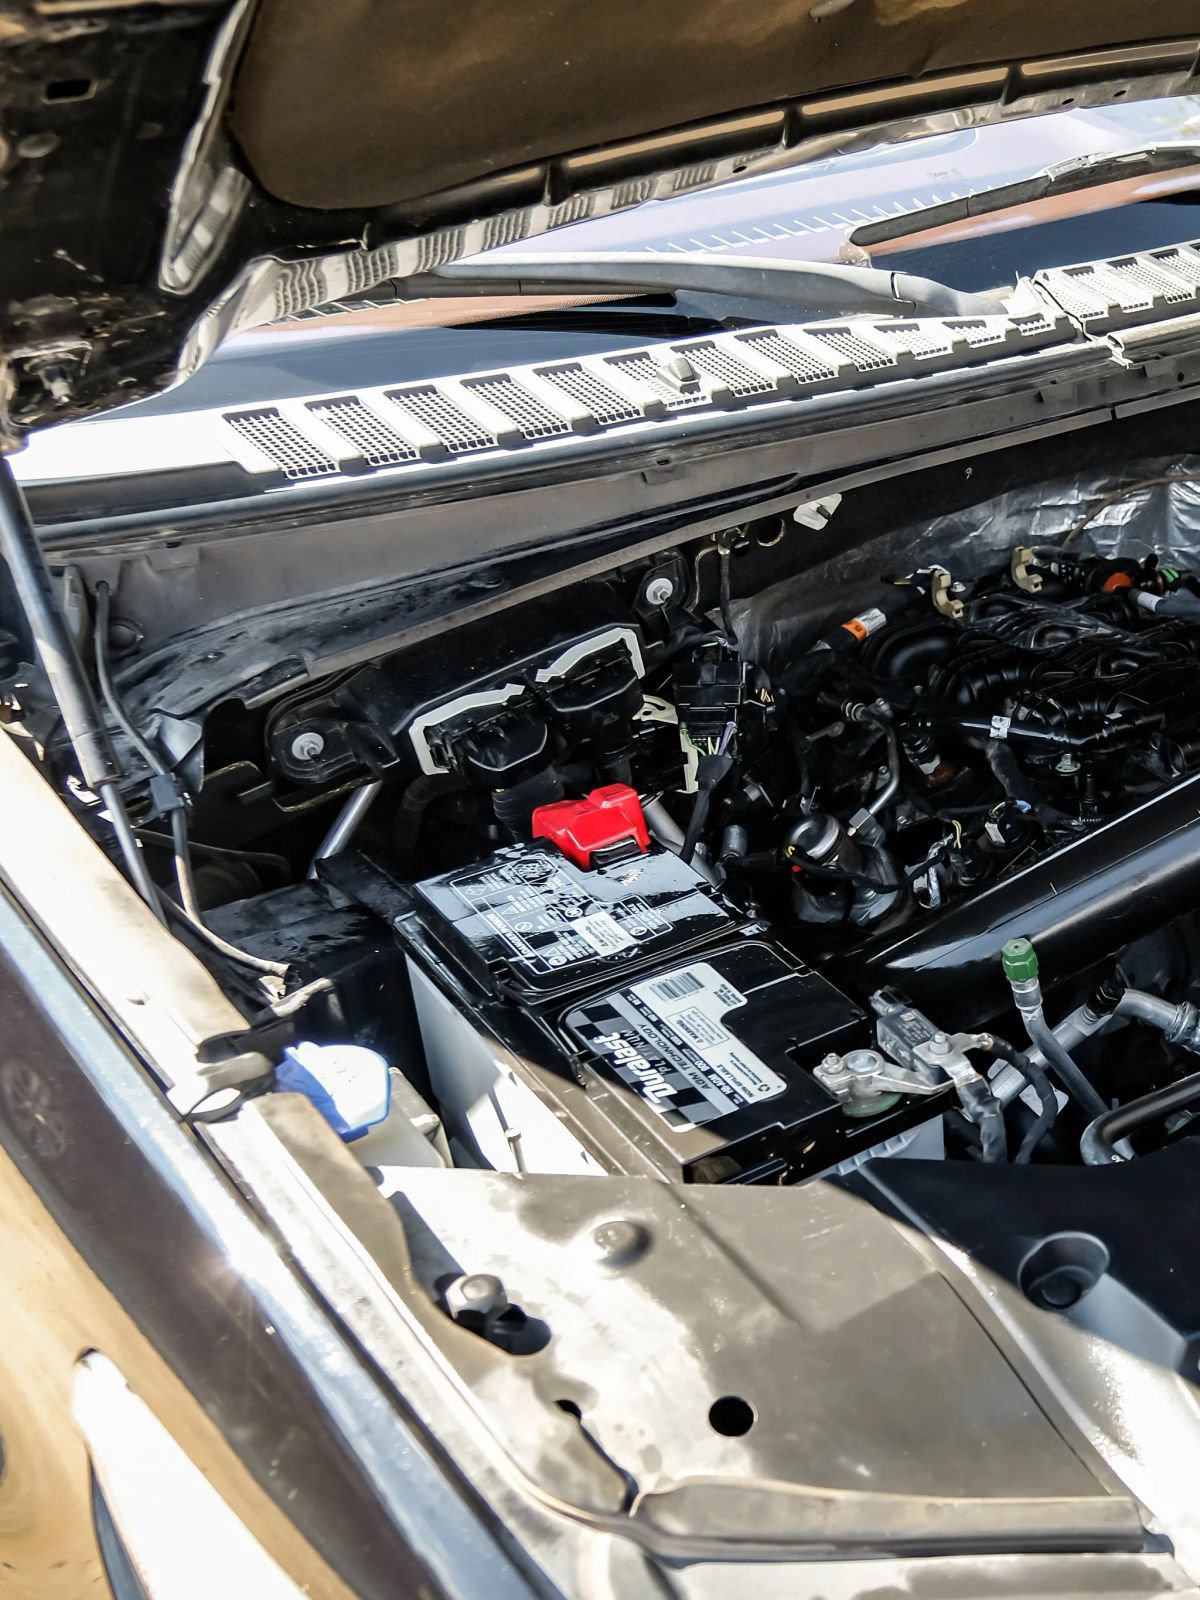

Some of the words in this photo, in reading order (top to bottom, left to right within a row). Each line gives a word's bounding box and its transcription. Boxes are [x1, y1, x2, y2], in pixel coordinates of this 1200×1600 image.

[593, 1031, 677, 1104] Duralast
[620, 1029, 671, 1076] PLATINUM
[636, 1024, 691, 1071] TECHNOLOGY
[687, 1071, 711, 1089] AGM
